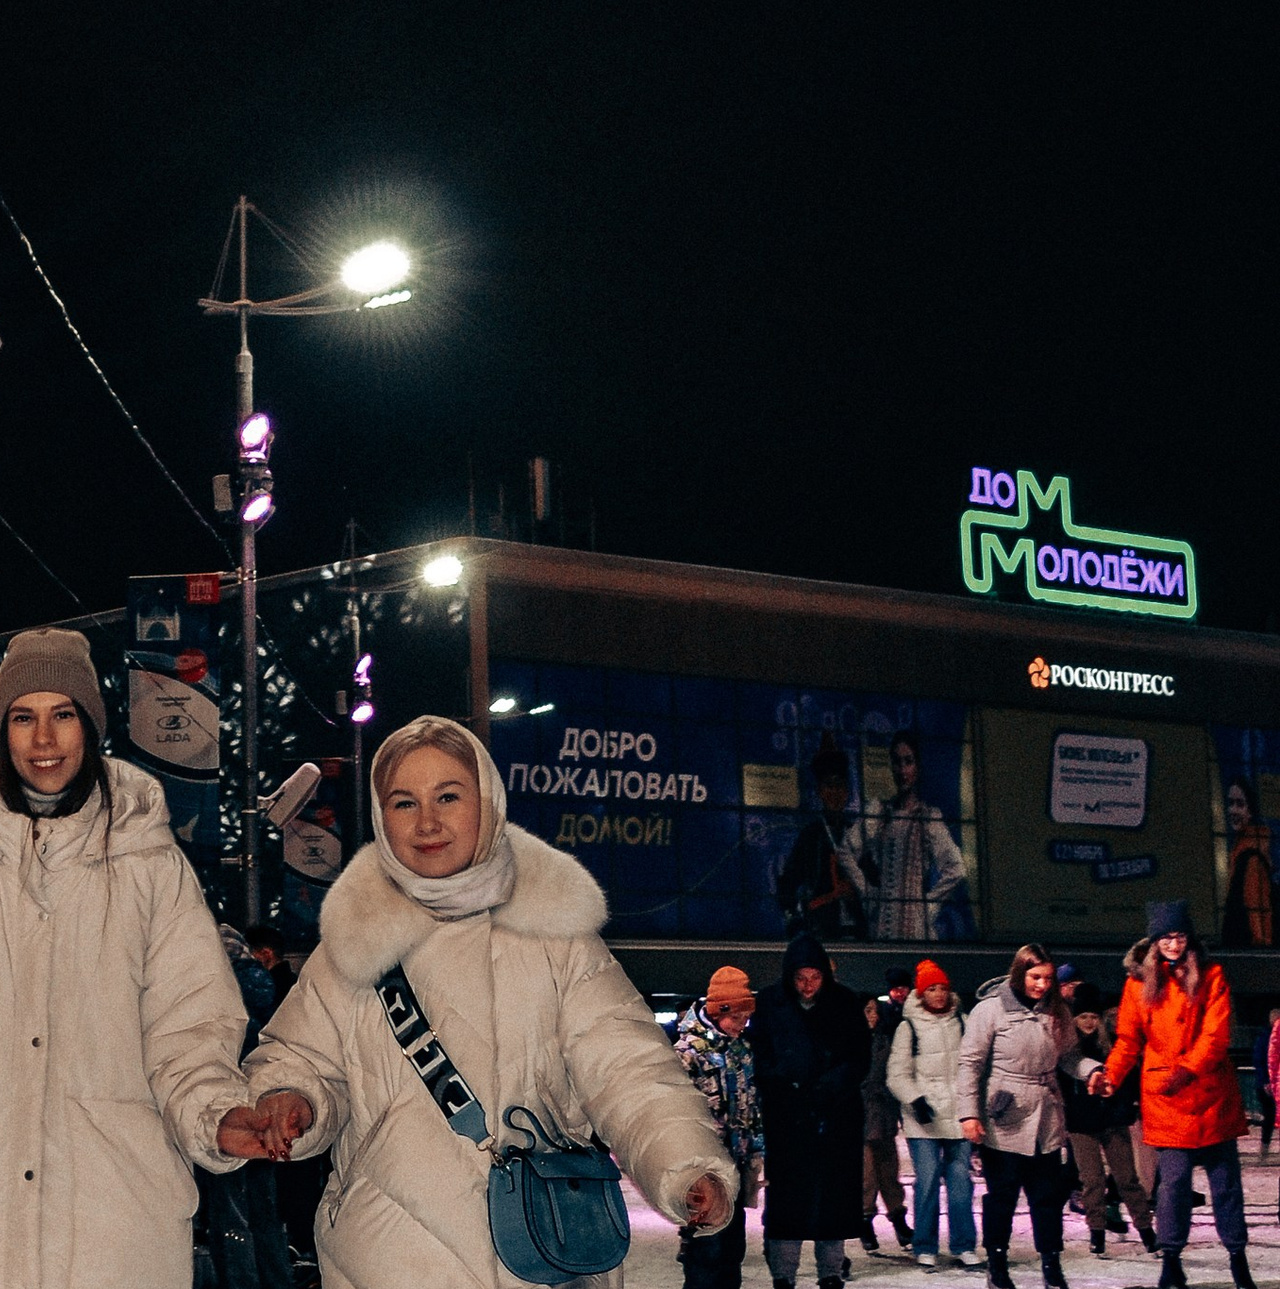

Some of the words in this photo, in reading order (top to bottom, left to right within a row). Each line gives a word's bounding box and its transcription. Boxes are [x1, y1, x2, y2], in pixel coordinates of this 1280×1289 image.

[1050, 664, 1175, 697] РОСКОНГРЕСС
[156, 733, 191, 744] LADA
[558, 726, 658, 763] ДОБРО
[508, 763, 709, 804] ПОЖАЛОВАТЬ
[555, 811, 672, 847] ДОМОЙ!
